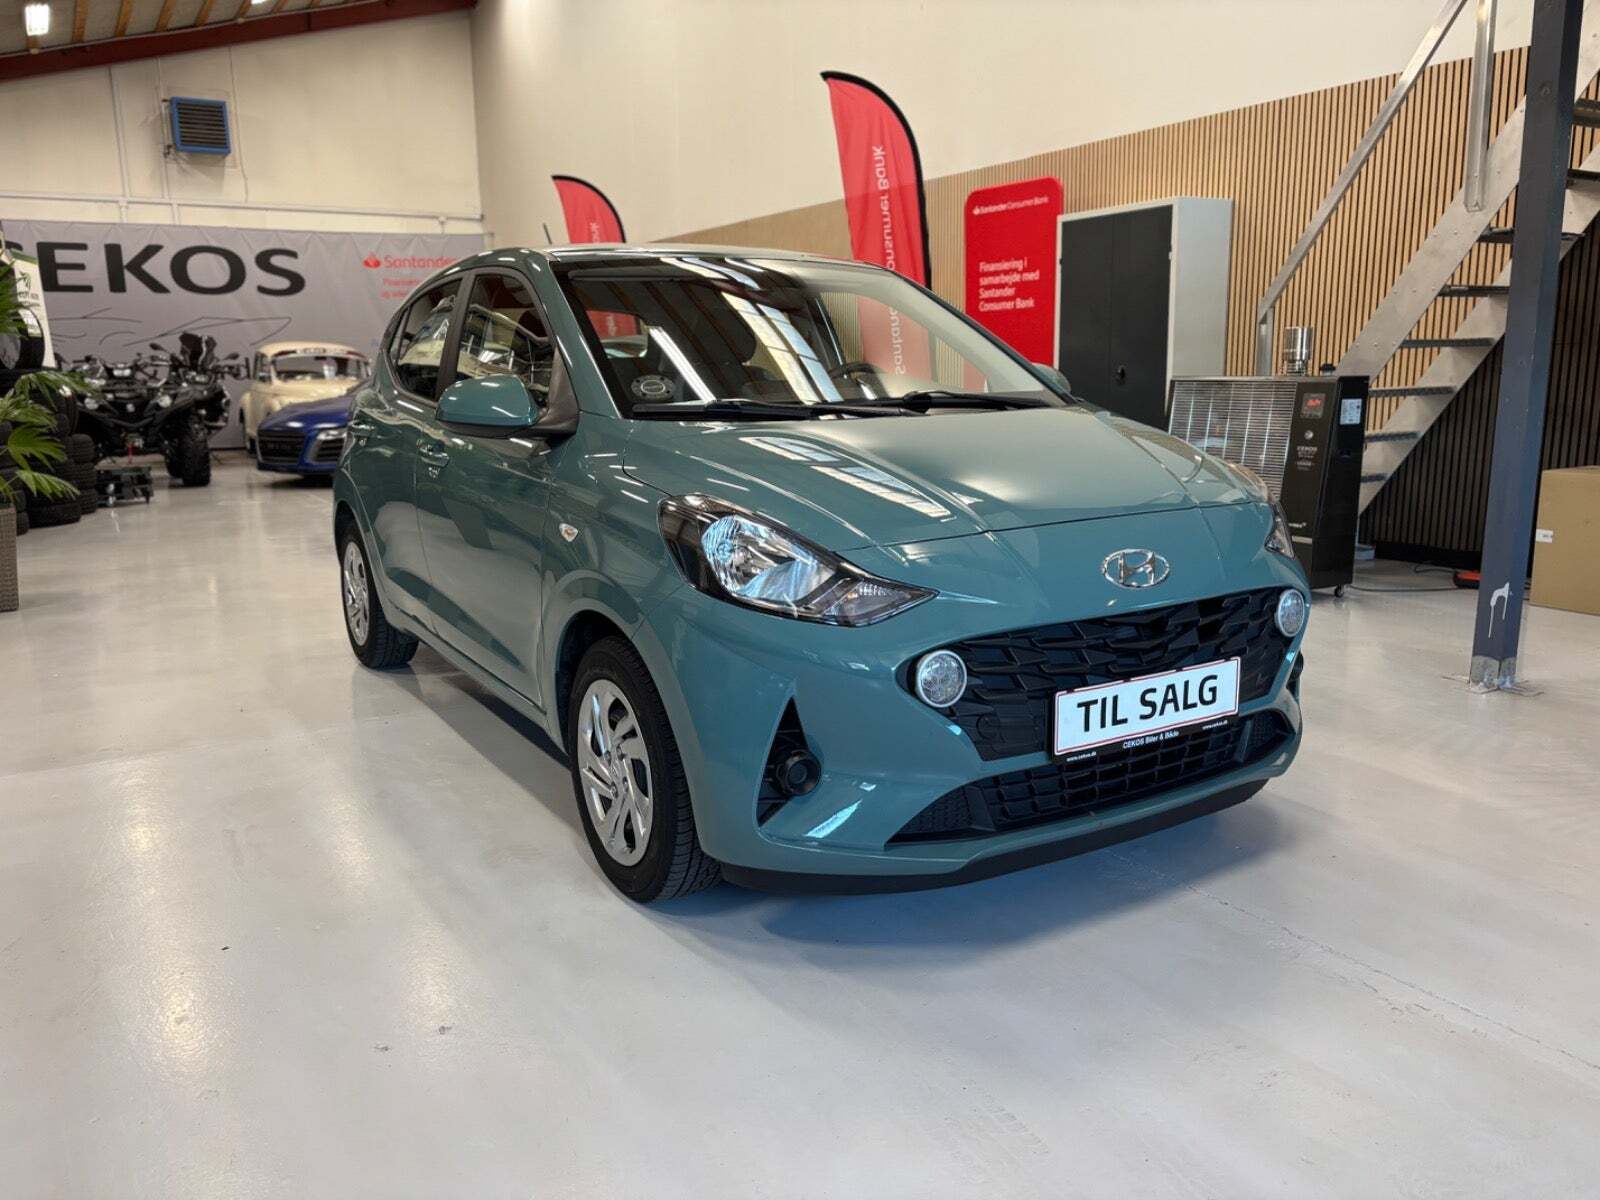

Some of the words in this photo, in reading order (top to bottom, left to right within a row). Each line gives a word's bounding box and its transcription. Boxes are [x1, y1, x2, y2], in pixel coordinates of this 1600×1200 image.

[979, 273, 1022, 286] samarbejde
[1022, 270, 1040, 281] med
[979, 286, 1017, 299] Santander
[979, 299, 1015, 312] Consumer
[1015, 297, 1035, 309] Bank
[1077, 694, 1128, 733] TIL
[1139, 675, 1218, 720] SALG
[1123, 737, 1145, 749] CEKOS
